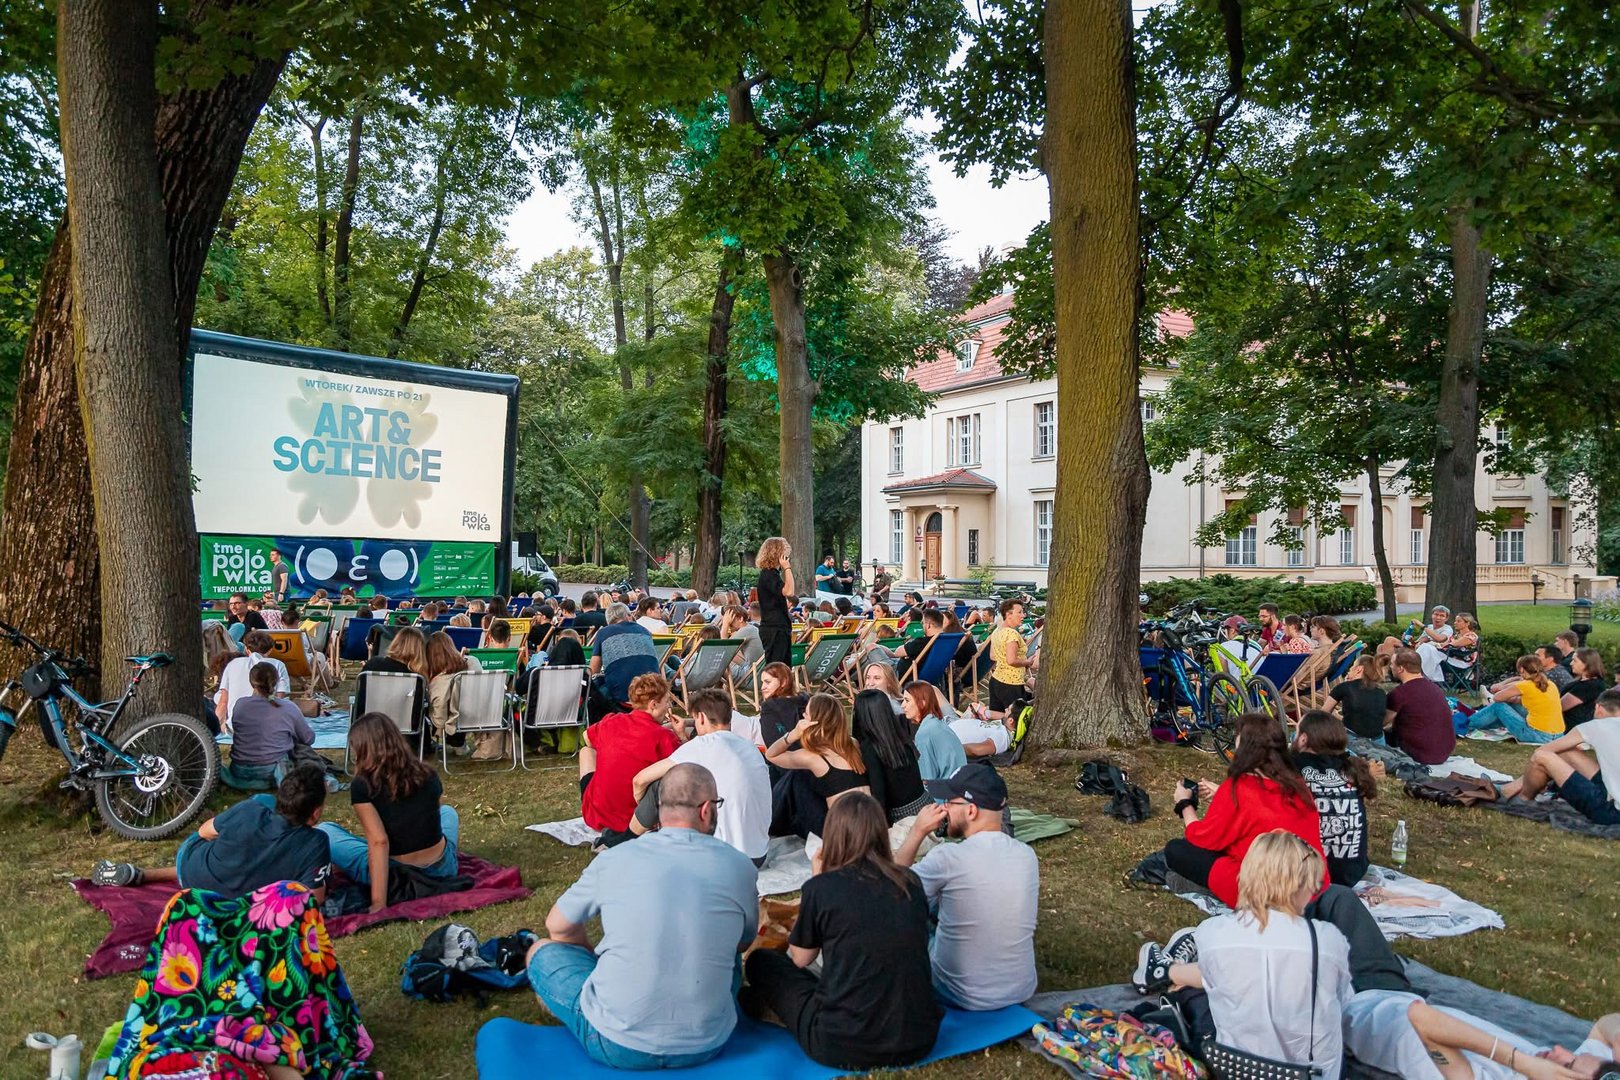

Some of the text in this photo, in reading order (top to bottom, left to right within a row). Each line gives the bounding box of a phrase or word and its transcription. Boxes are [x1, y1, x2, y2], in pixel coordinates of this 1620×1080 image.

[355, 385, 396, 398] ZAWSZE
[397, 391, 411, 399] PO
[412, 393, 424, 401] 21
[313, 402, 411, 445] ART&
[273, 435, 442, 483] SCIENCE
[462, 513, 488, 526] poló
[213, 542, 243, 554] tme
[212, 549, 266, 577] poló
[222, 568, 273, 585] wka
[1314, 798, 1360, 813] OVE
